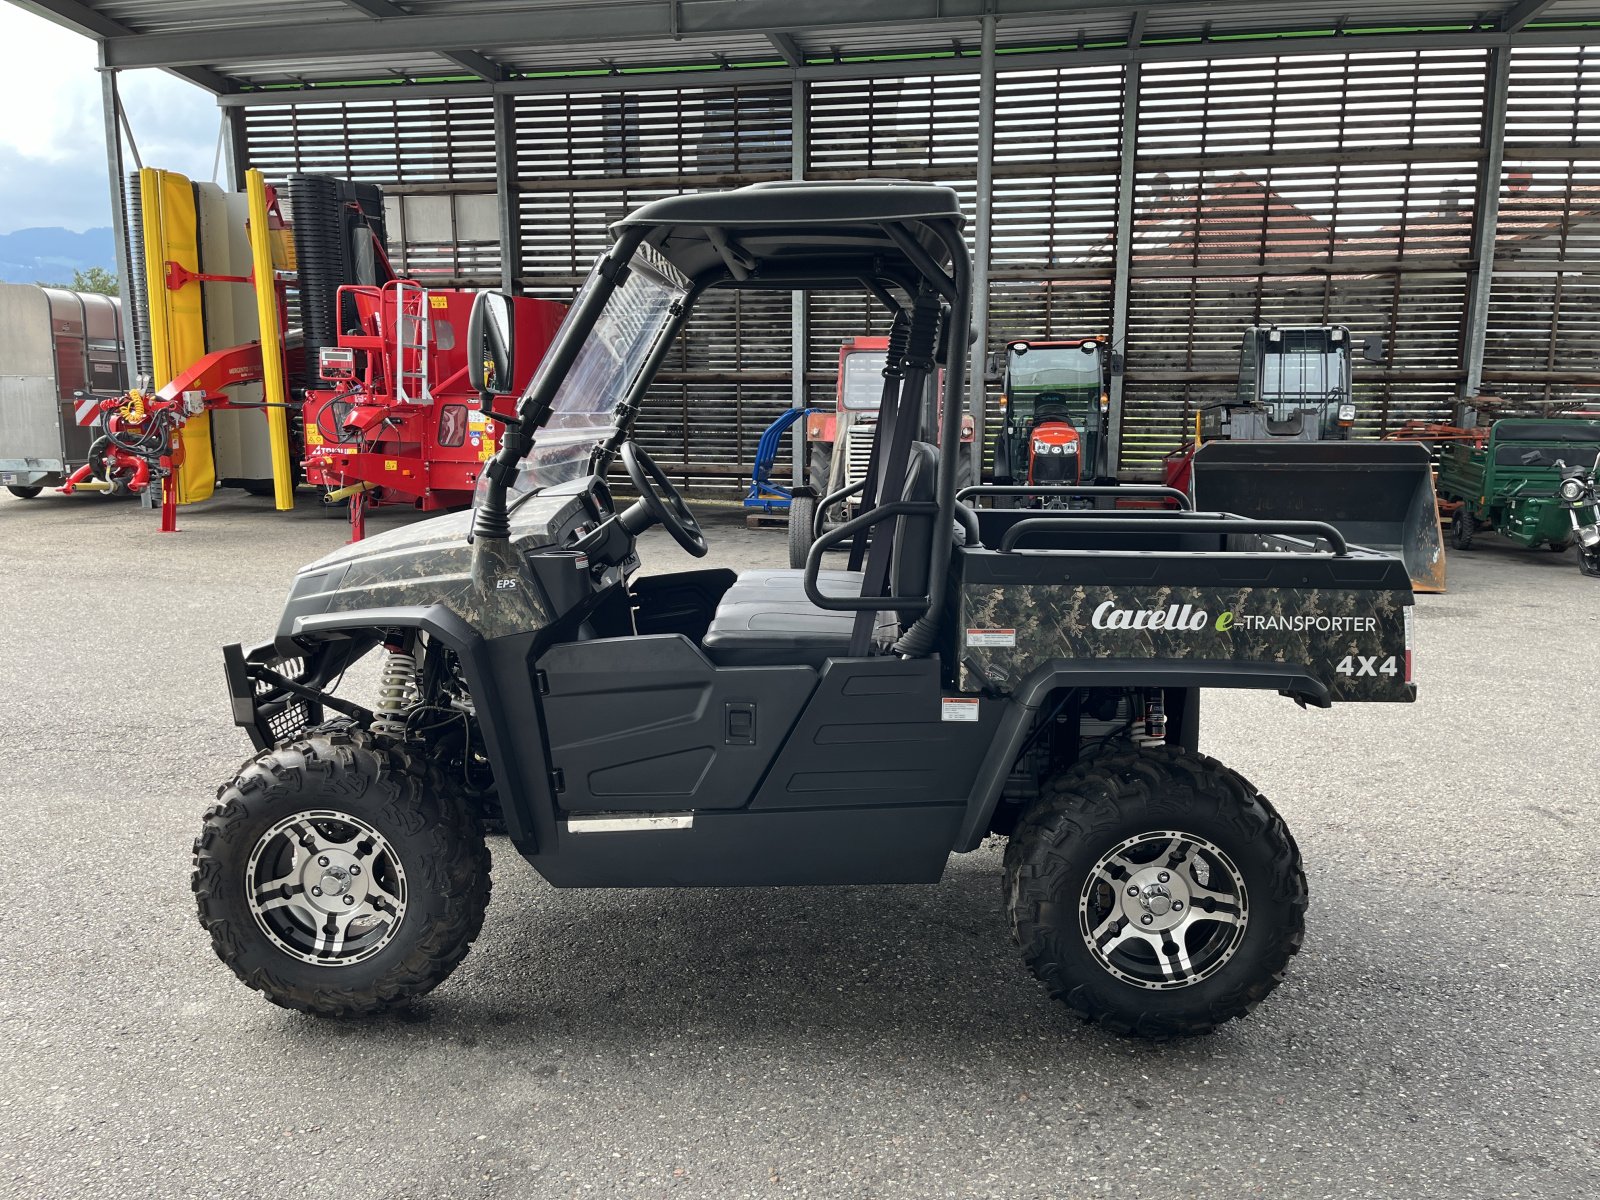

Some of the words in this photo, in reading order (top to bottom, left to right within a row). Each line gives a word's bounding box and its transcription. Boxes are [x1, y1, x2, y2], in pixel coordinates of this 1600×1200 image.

[496, 579, 516, 589] EPS
[1091, 600, 1208, 631] Carello
[1215, 611, 1376, 632] e-TRANSPORTER
[1335, 655, 1398, 677] 4X4
